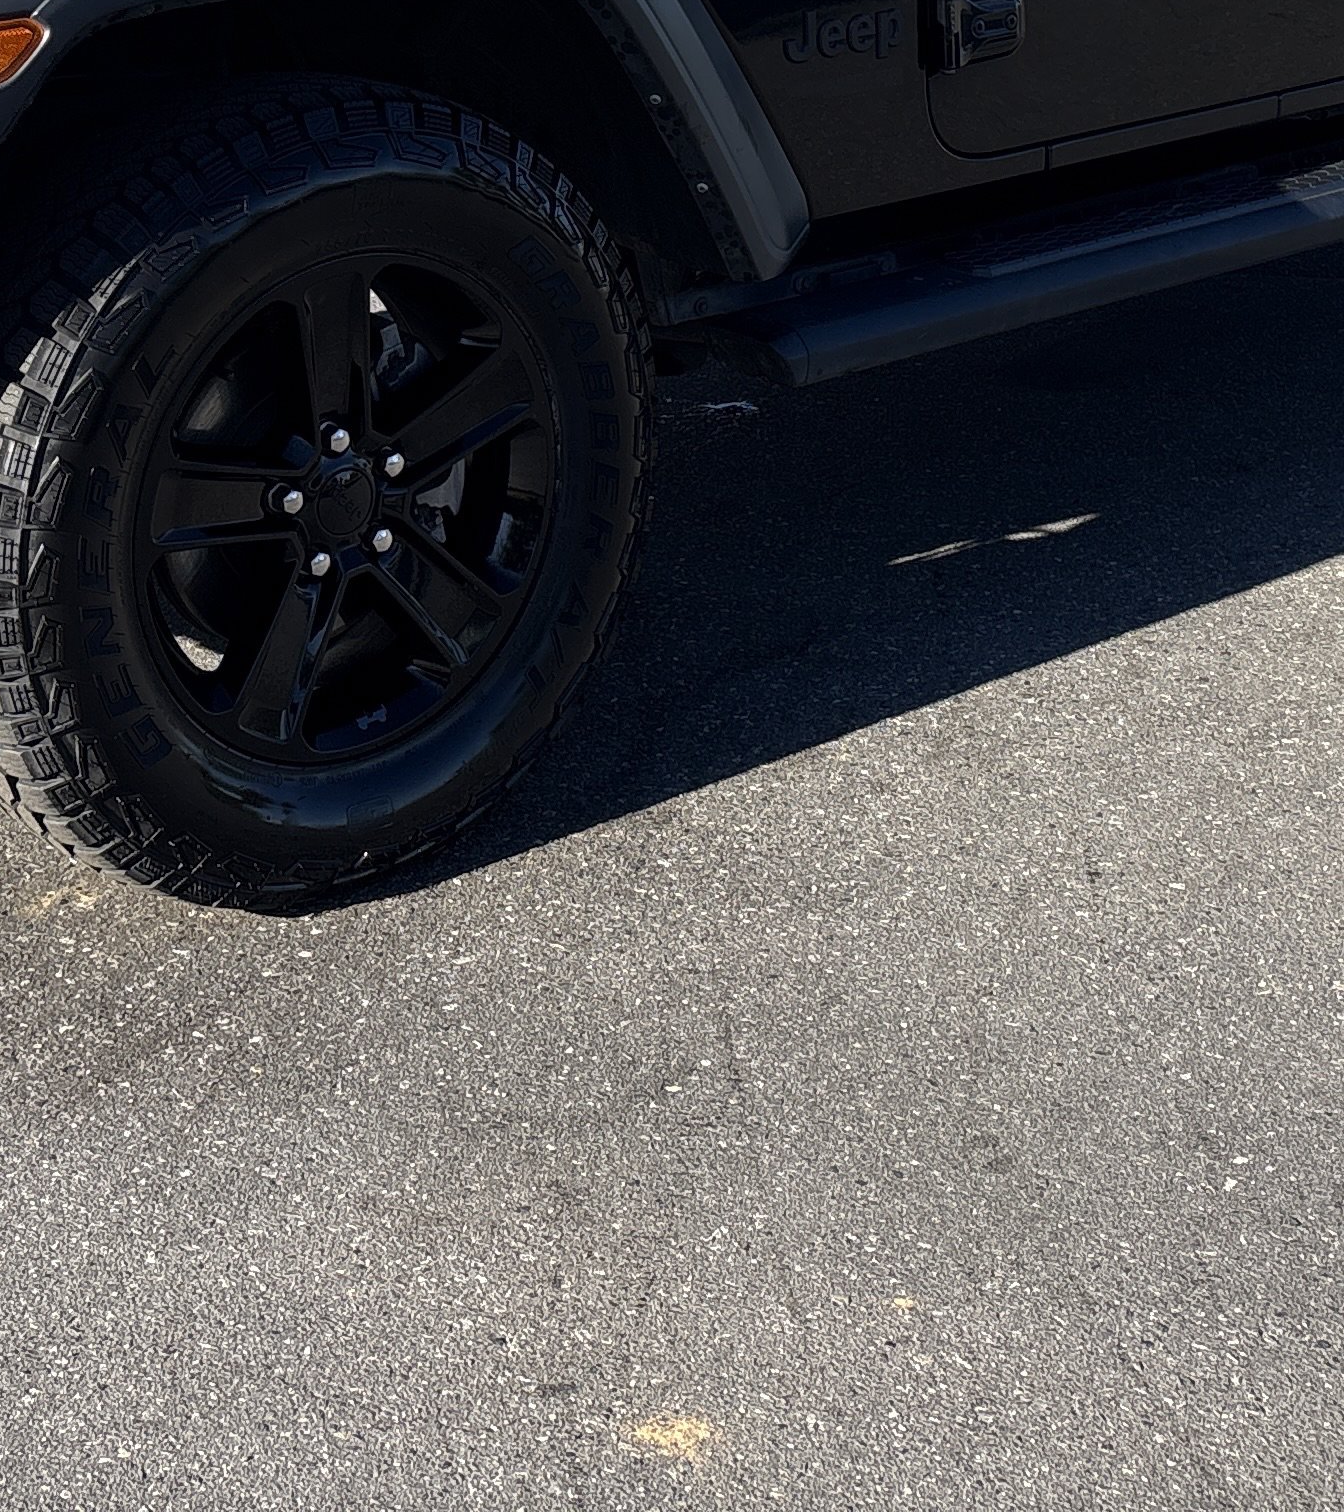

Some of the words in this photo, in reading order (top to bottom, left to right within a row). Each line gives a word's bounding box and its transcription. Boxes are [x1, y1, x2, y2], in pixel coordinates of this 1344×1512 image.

[781, 7, 904, 65] Jeep
[77, 343, 176, 770] GENERAL
[508, 235, 620, 561] GRABBER
